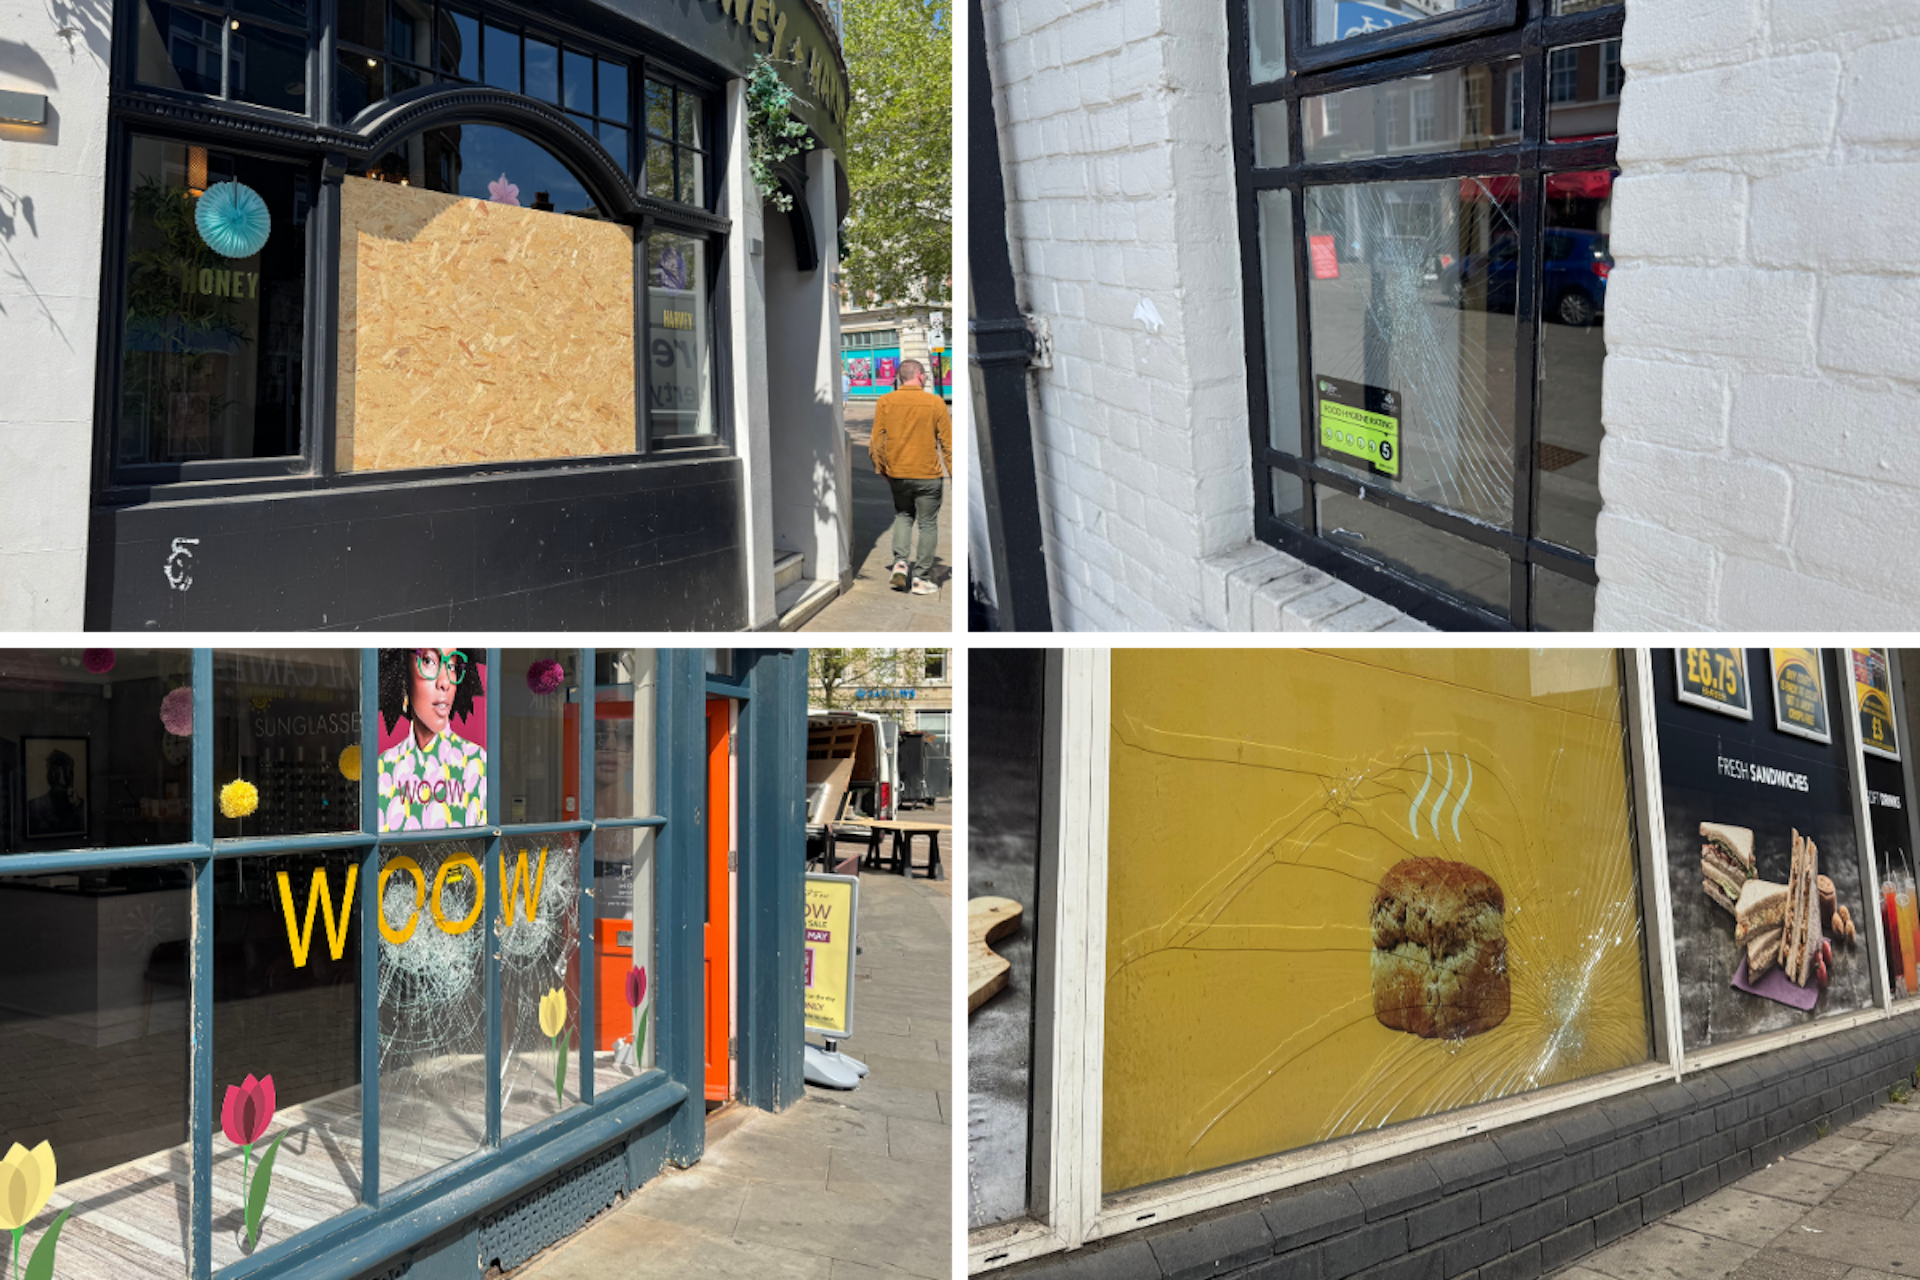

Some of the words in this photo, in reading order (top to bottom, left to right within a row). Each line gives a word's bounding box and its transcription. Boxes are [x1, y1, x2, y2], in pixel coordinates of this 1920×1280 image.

[181, 266, 259, 299] HONEY
[663, 310, 693, 330] HARVEY
[1325, 404, 1341, 417] FOOD
[1370, 416, 1394, 430] RATING
[1381, 443, 1390, 459] 5
[1687, 647, 1737, 695] £6.75
[255, 711, 361, 737] SUNGLASSE
[1718, 756, 1749, 780] FRESH
[1750, 763, 1809, 792] SANDWICHES
[398, 780, 466, 805] WOOW
[276, 847, 549, 968] WOOW
[807, 931, 828, 941] MAY
[808, 920, 828, 929] SALE
